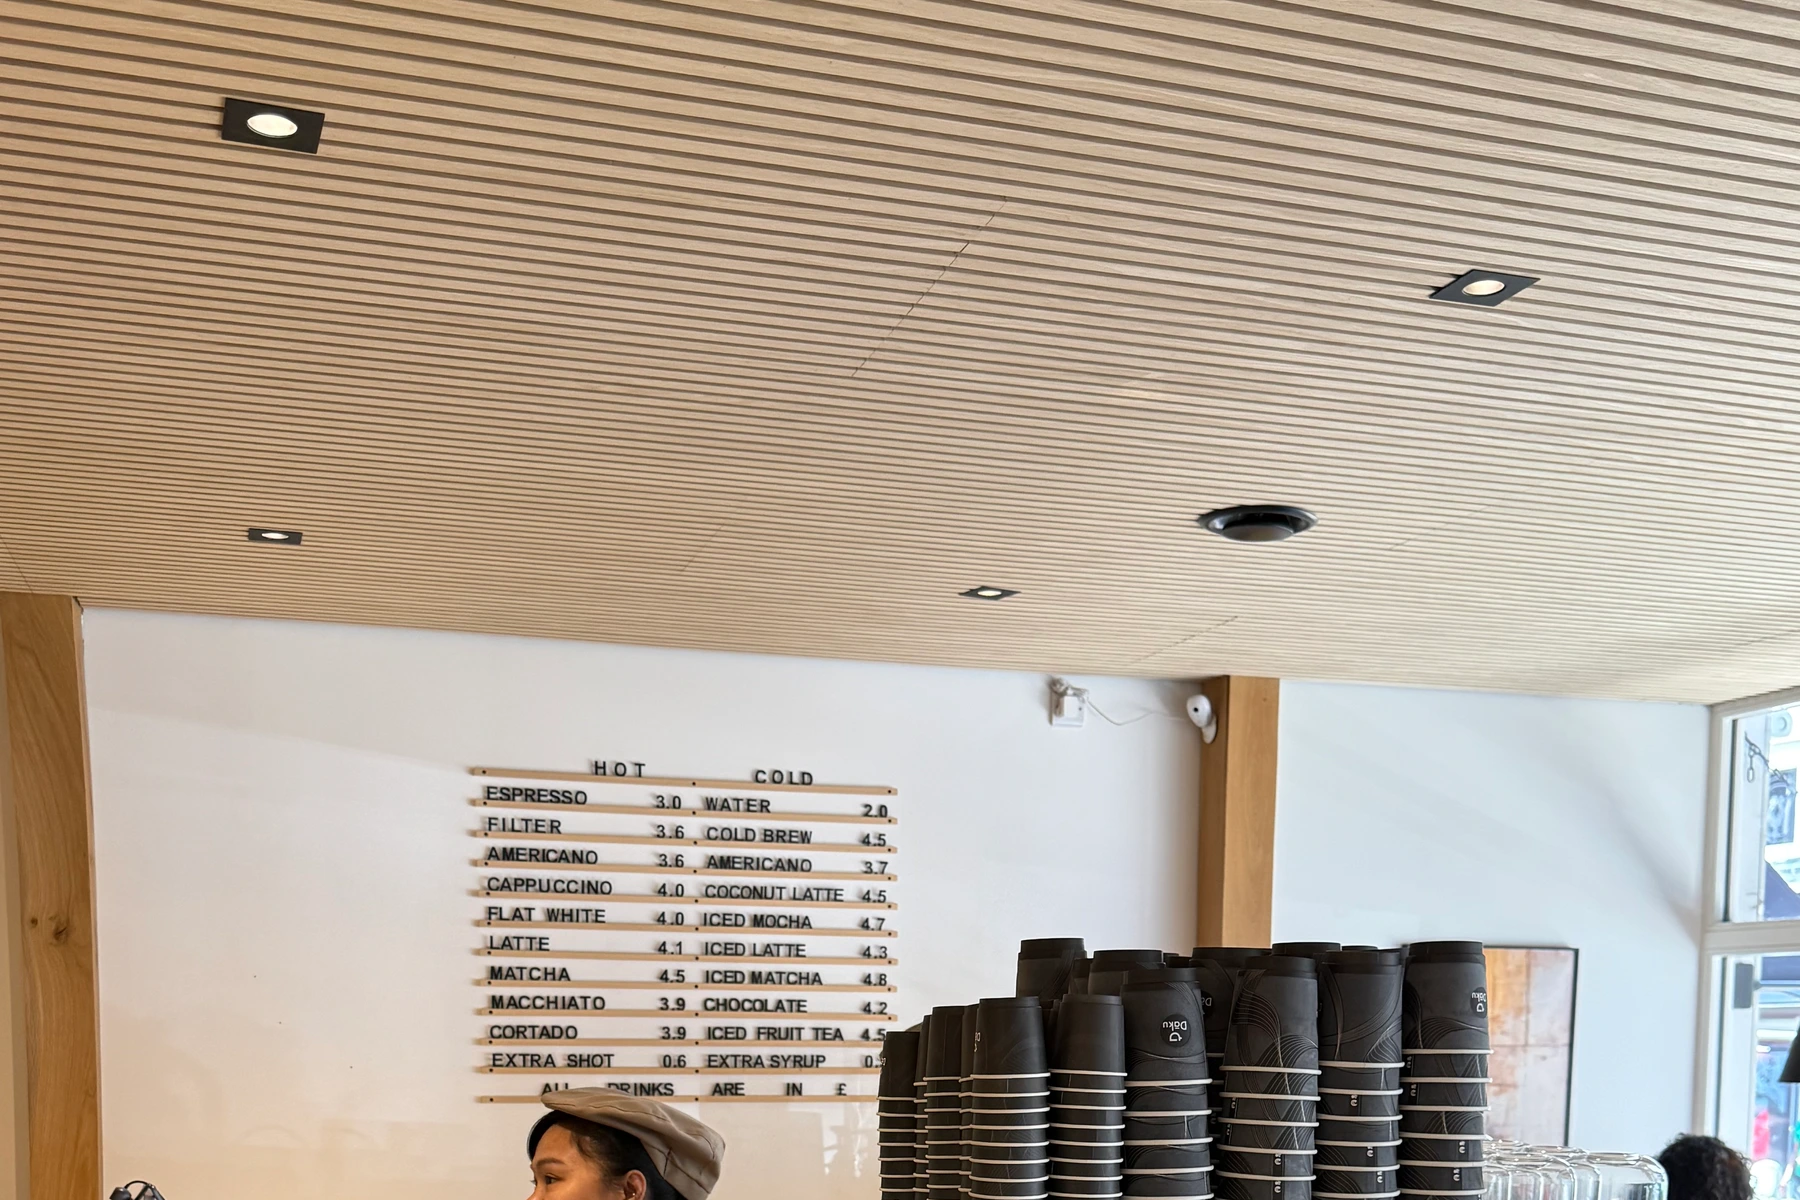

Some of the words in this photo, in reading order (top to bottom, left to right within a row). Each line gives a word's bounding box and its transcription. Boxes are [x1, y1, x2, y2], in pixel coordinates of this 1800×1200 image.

[594, 760, 646, 778] HOT
[754, 769, 813, 786] COLD
[486, 786, 588, 805] ESPRESSO
[656, 795, 682, 810] 3.0
[705, 797, 771, 813] WATER
[862, 804, 888, 818] 2.0
[487, 817, 562, 834] FILTER
[656, 824, 685, 839] 3.6
[706, 826, 756, 842] COLD
[763, 829, 813, 845] BREW
[861, 833, 887, 847] 4.5
[487, 846, 598, 865] AMERICANO
[658, 853, 685, 868] 3.6
[707, 854, 812, 872] AMERICANO
[864, 861, 888, 875] 3.7
[487, 877, 612, 895] CAPPUCCINO
[657, 883, 685, 897] 4.0
[705, 884, 786, 901] COCONUT
[792, 887, 845, 902] LATTE
[862, 889, 887, 903] 4.5
[488, 906, 536, 922] FLAT
[546, 908, 606, 924] WHITE
[656, 912, 685, 926] 4.0
[703, 912, 746, 928] ICED
[753, 914, 813, 929] MOCHA
[861, 917, 886, 931] 4.7
[489, 935, 550, 952] LATTE
[657, 941, 683, 955] 4.1
[704, 942, 746, 957] ICED
[752, 942, 807, 958] LATTE
[862, 945, 888, 959] 4.3
[490, 965, 571, 982] MATCHA
[659, 969, 685, 983] 4.5
[705, 970, 746, 984] ICED
[751, 971, 823, 986] MATCHA
[863, 973, 887, 986] 4.8
[491, 995, 606, 1010] MACCHIATO
[659, 997, 686, 1011] 3.9
[703, 997, 808, 1013] CHOCOLATE
[862, 1001, 888, 1015] 4.2
[490, 1025, 578, 1040] CORTADO
[661, 1026, 687, 1040] 3.9
[707, 1026, 747, 1040] ICED
[757, 1026, 805, 1041] FRUIT
[812, 1027, 845, 1041] TEA
[861, 1028, 886, 1041] 4.5
[1162, 1020, 1187, 1032] Dāku
[492, 1053, 556, 1068] EXTRA
[567, 1053, 615, 1068] SHOT
[663, 1054, 687, 1068] 0.6
[707, 1054, 765, 1068] EXTRA
[769, 1054, 826, 1068] SYRUP
[864, 1055, 881, 1068] 0.
[712, 1082, 745, 1096] ARE
[786, 1082, 803, 1096] IN
[836, 1082, 847, 1096] £
